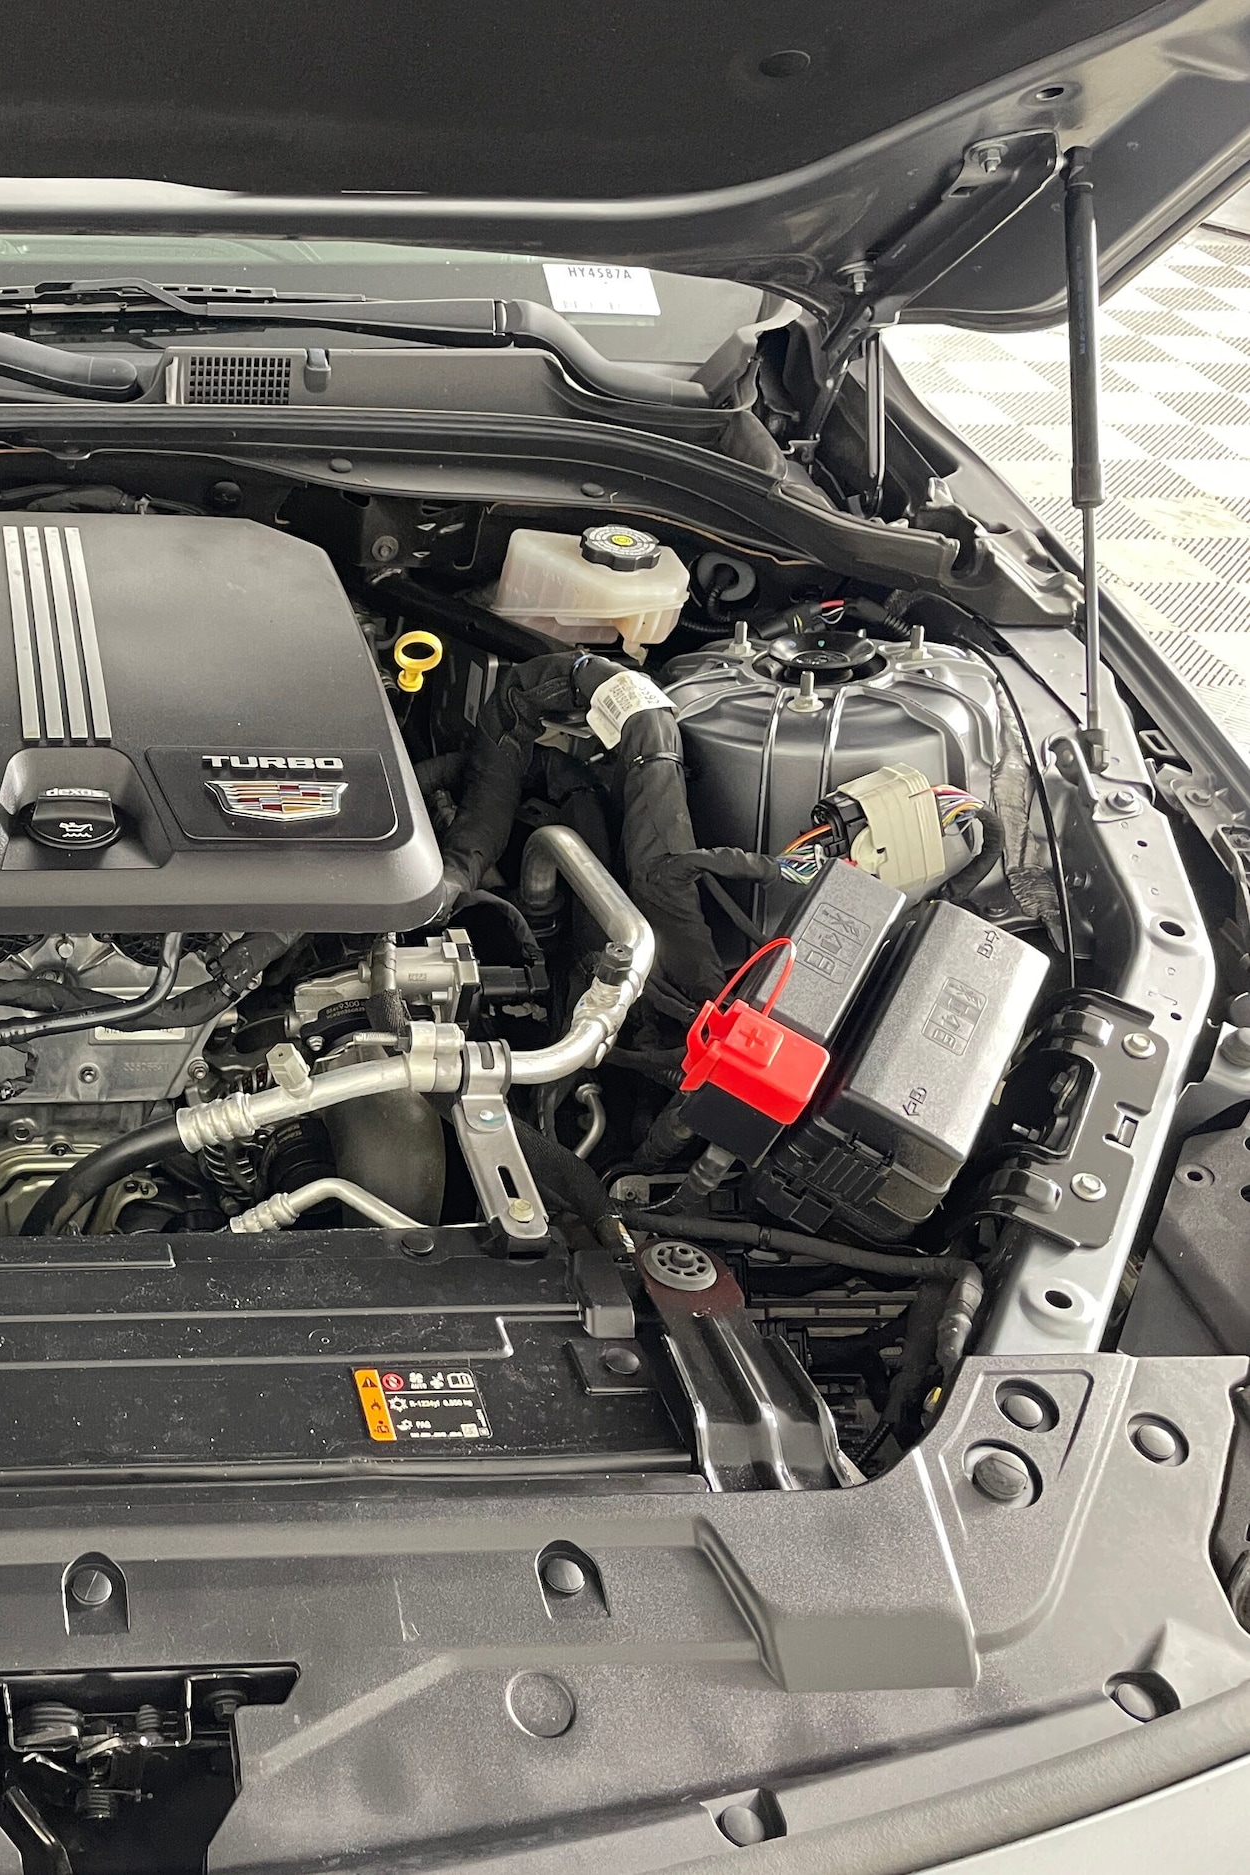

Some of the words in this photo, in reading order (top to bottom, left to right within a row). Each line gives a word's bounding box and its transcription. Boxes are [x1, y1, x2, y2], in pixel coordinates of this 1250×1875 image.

[568, 266, 632, 279] HY4587A
[202, 755, 344, 770] TURBO
[46, 787, 105, 798] dexos
